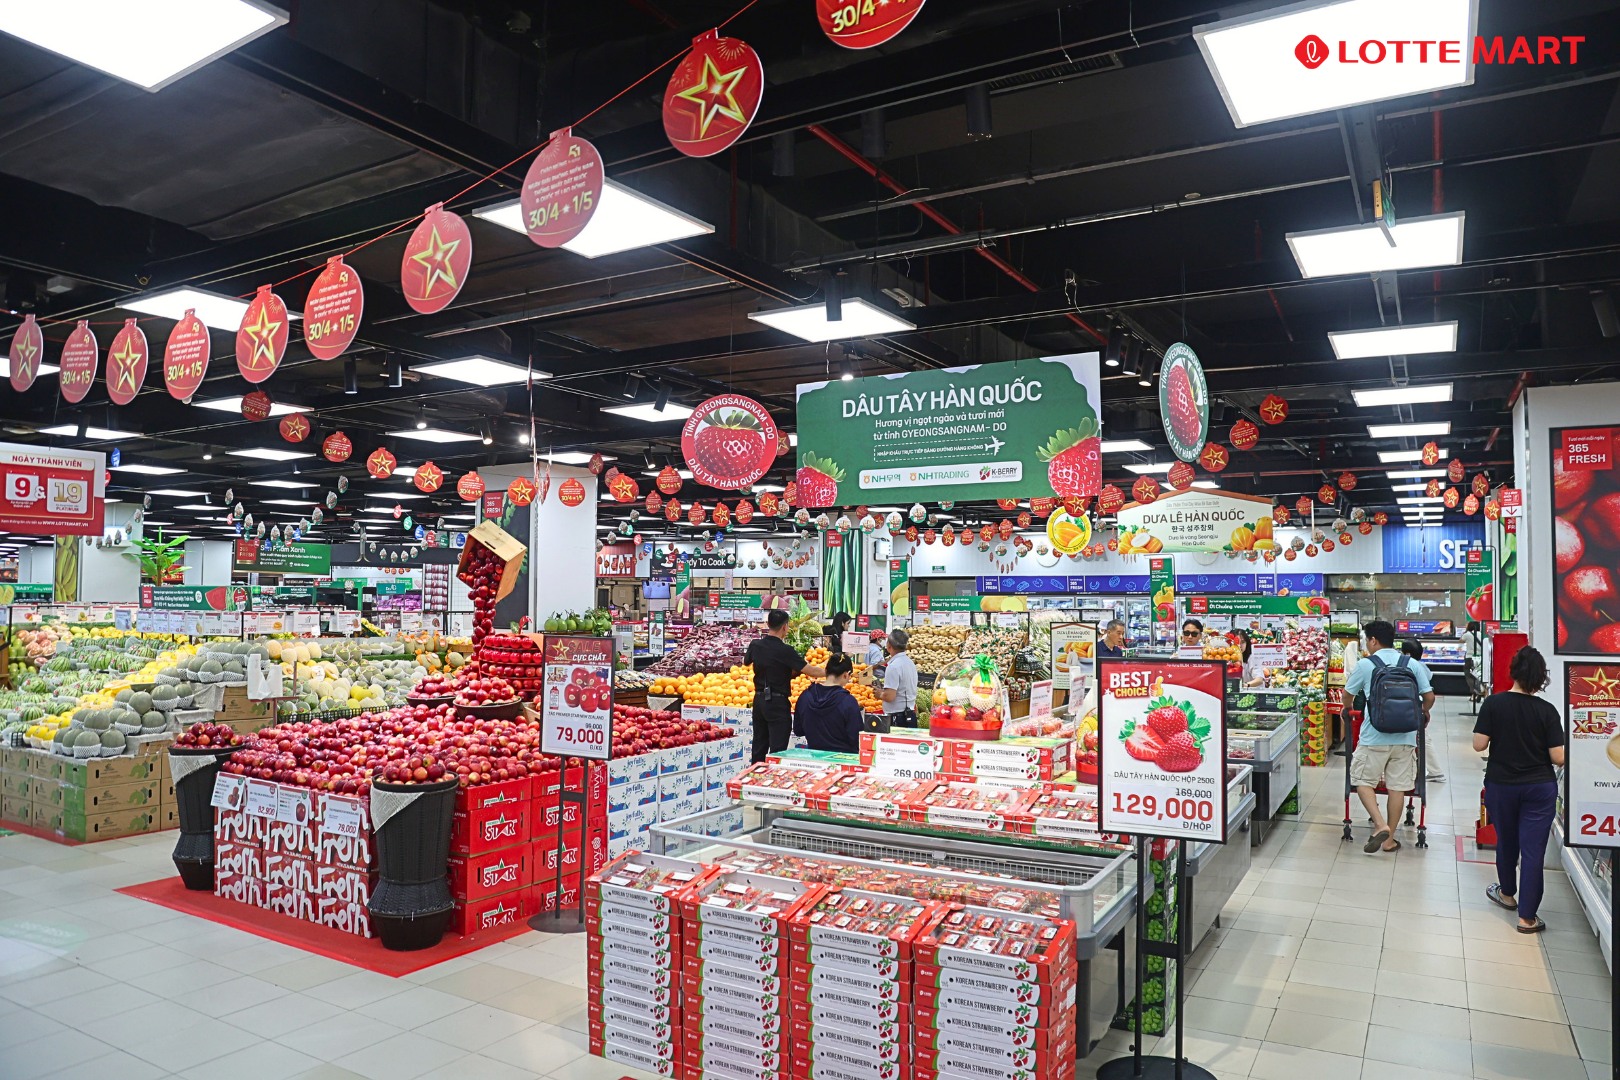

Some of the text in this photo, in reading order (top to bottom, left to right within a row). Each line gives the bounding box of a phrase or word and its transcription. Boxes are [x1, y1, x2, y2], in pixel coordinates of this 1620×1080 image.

[528, 190, 593, 229] 30/4 1/5
[309, 314, 354, 341] 30/4 1/5
[842, 376, 1042, 418] DÂU TÂY HÀN QUỐC
[875, 409, 1005, 428] Hương vị ngọt ngào và tươi mới
[685, 418, 698, 437] TỈNH
[873, 431, 883, 440] từ
[884, 430, 900, 439] tỉnh
[992, 422, 1007, 432] DO
[1568, 443, 1589, 453] 365
[12, 455, 82, 468] NGÀY THÀNH VIÊN
[1569, 454, 1606, 464] FRESH
[688, 458, 763, 488] DÂU TÂY HÀN QUỐC
[15, 477, 83, 503] 9 & 19
[1143, 508, 1245, 524] DƯA LÊ HÀN QUỐC
[599, 553, 633, 575] MEAT
[699, 558, 707, 566] To
[708, 557, 726, 566] Cook
[573, 654, 587, 663] CỰC
[588, 652, 606, 661] CHẤT
[1110, 671, 1152, 689] BEST
[1115, 688, 1148, 697] CHOICE
[557, 726, 604, 745] 79,000
[995, 749, 1021, 757] STRAWBERRY
[1114, 771, 1215, 785] DÂU TÂY HÀN QUỐC HỘP 250G
[258, 805, 275, 816] 82,900
[1112, 792, 1213, 821] 129,000
[337, 823, 356, 834] 79,000
[1580, 813, 1620, 837] 24
[712, 910, 753, 923] KOREAN STRAWBERRY
[824, 933, 870, 946] KOREAN STRAWBERRY
[953, 955, 1006, 970] KOREAN STRAWBERRY
[955, 976, 1008, 992] KOREAN STRAWBERRY
[954, 998, 1006, 1014] KOREAN STRAWBERRY
